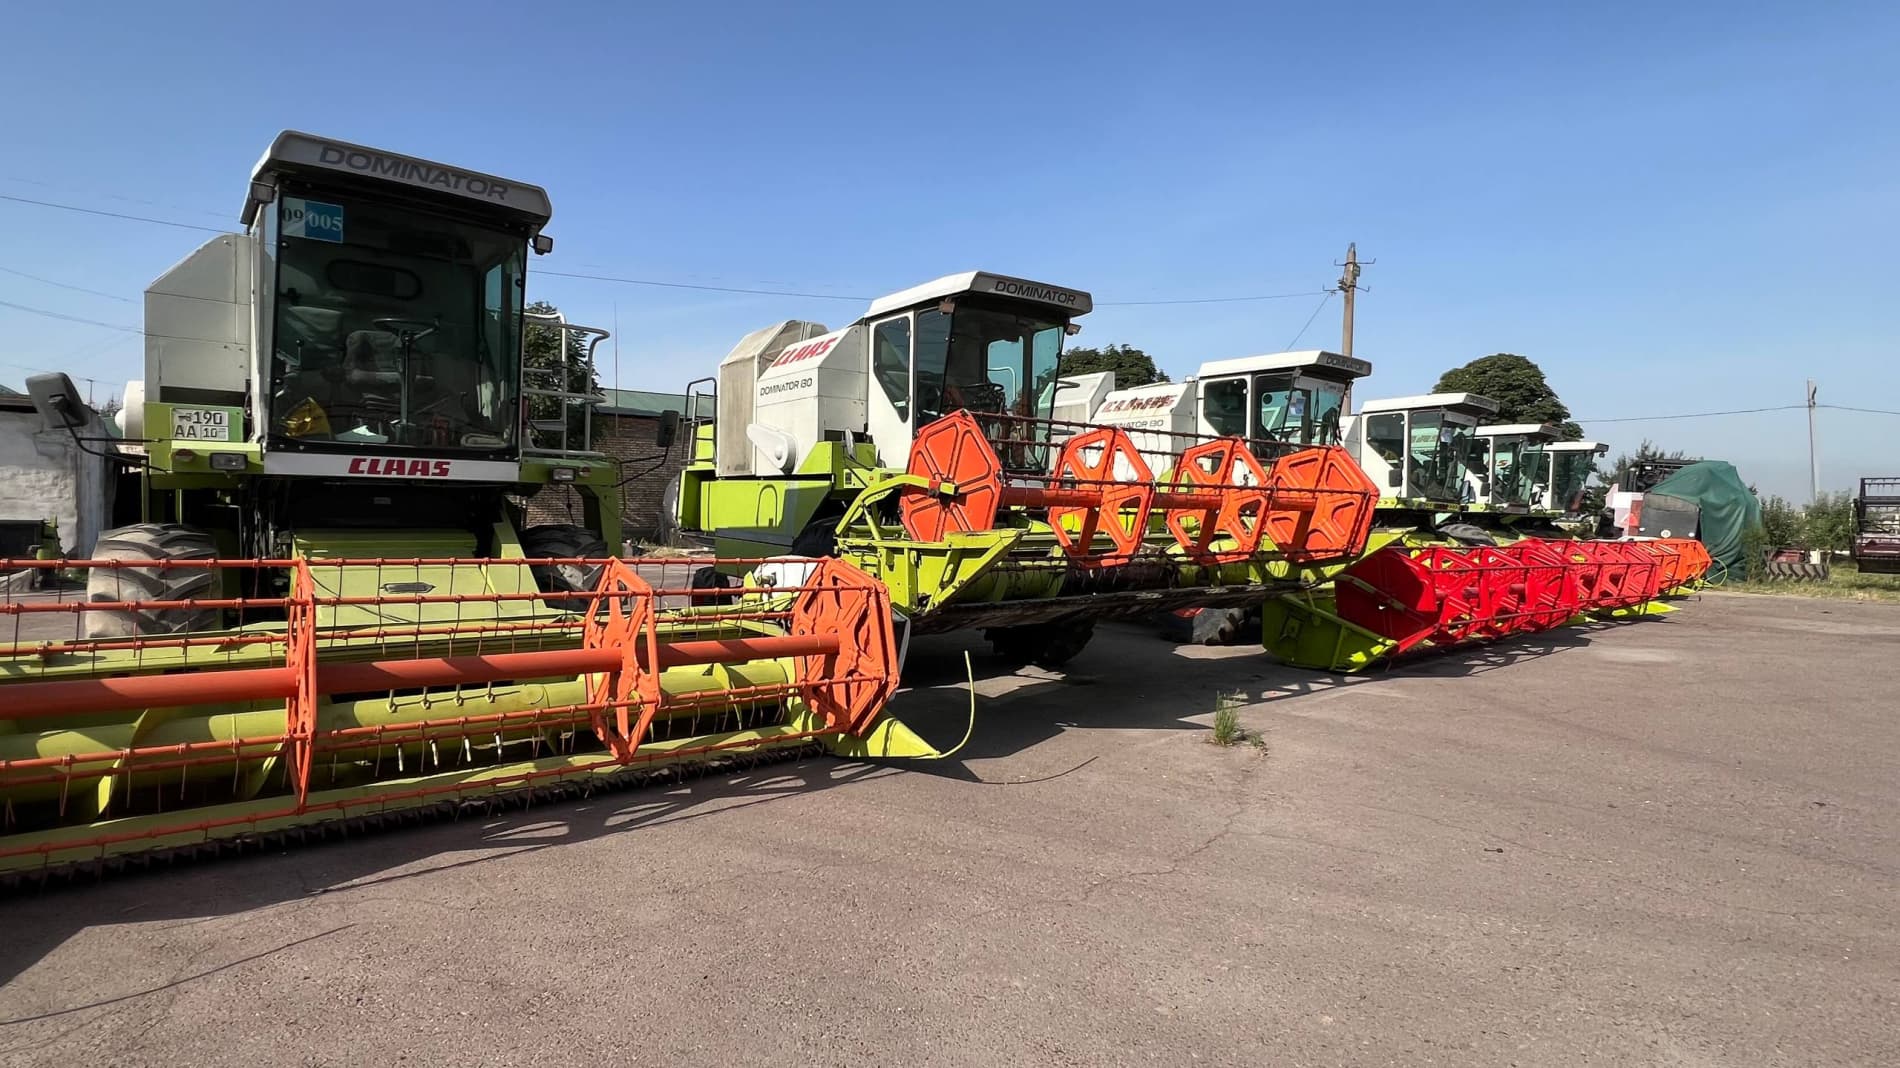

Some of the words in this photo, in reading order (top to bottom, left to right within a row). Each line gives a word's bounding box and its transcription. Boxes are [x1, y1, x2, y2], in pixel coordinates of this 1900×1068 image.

[319, 146, 508, 200] DOMINATOR
[995, 281, 1076, 304] DOMINATOR
[771, 337, 838, 367] CLAAS
[760, 381, 799, 396] DOMINATOR
[175, 425, 197, 438] AA
[203, 427, 217, 438] 10
[348, 458, 451, 477] CLAAS
